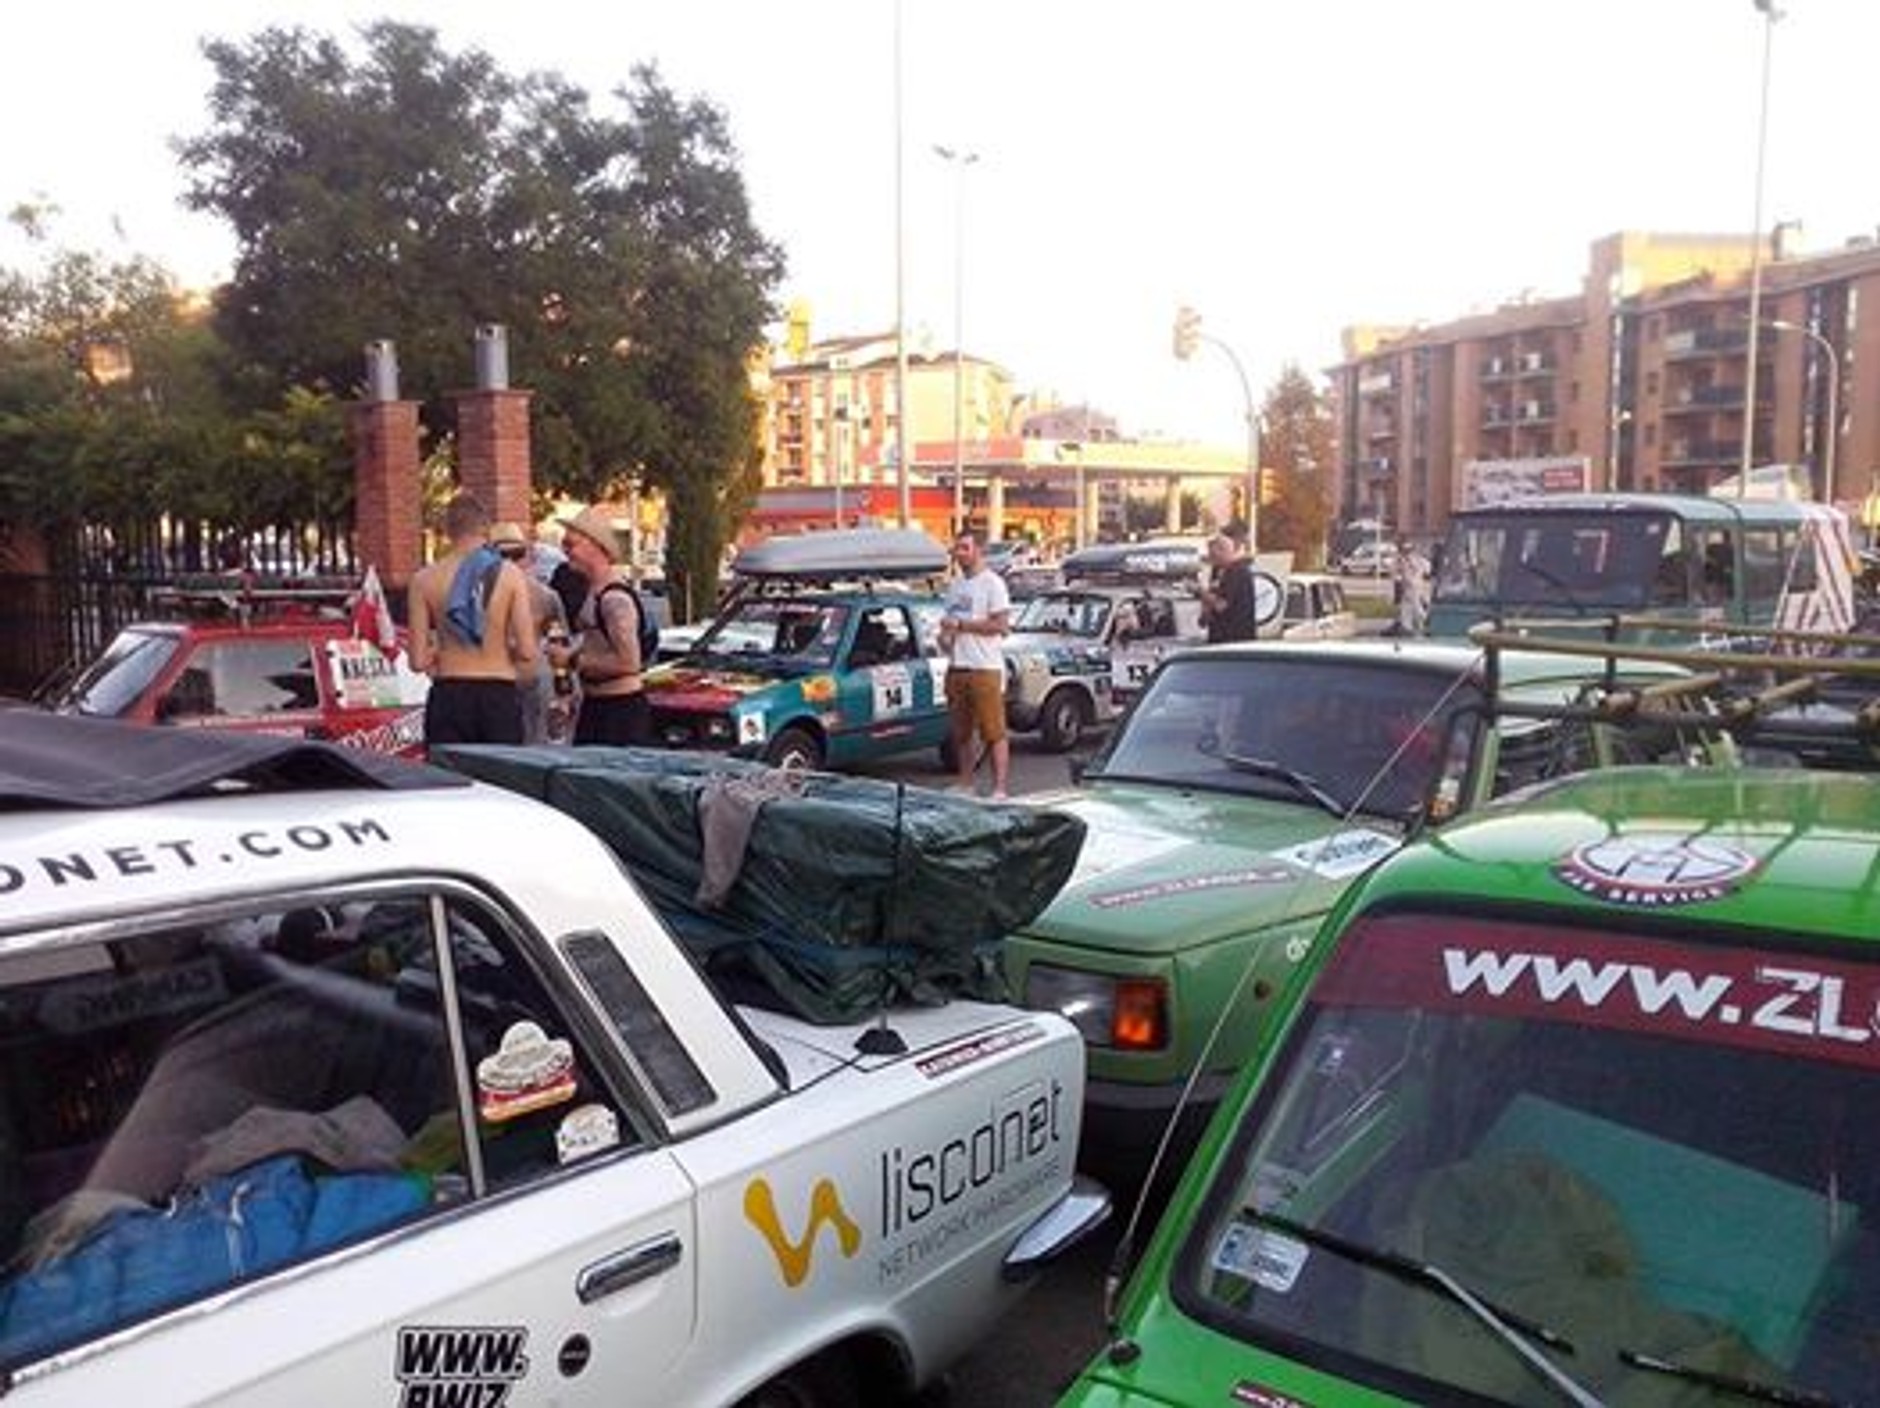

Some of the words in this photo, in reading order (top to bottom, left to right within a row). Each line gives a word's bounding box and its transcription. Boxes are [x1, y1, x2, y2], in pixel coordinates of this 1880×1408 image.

[1127, 665, 1150, 682] 13
[1608, 885, 1723, 903] SERVICE
[1443, 948, 1880, 1042] www.ZL
[876, 1079, 1062, 1239] lisconet
[879, 1211, 970, 1286] NETWORK
[402, 1331, 525, 1375] WWW.
